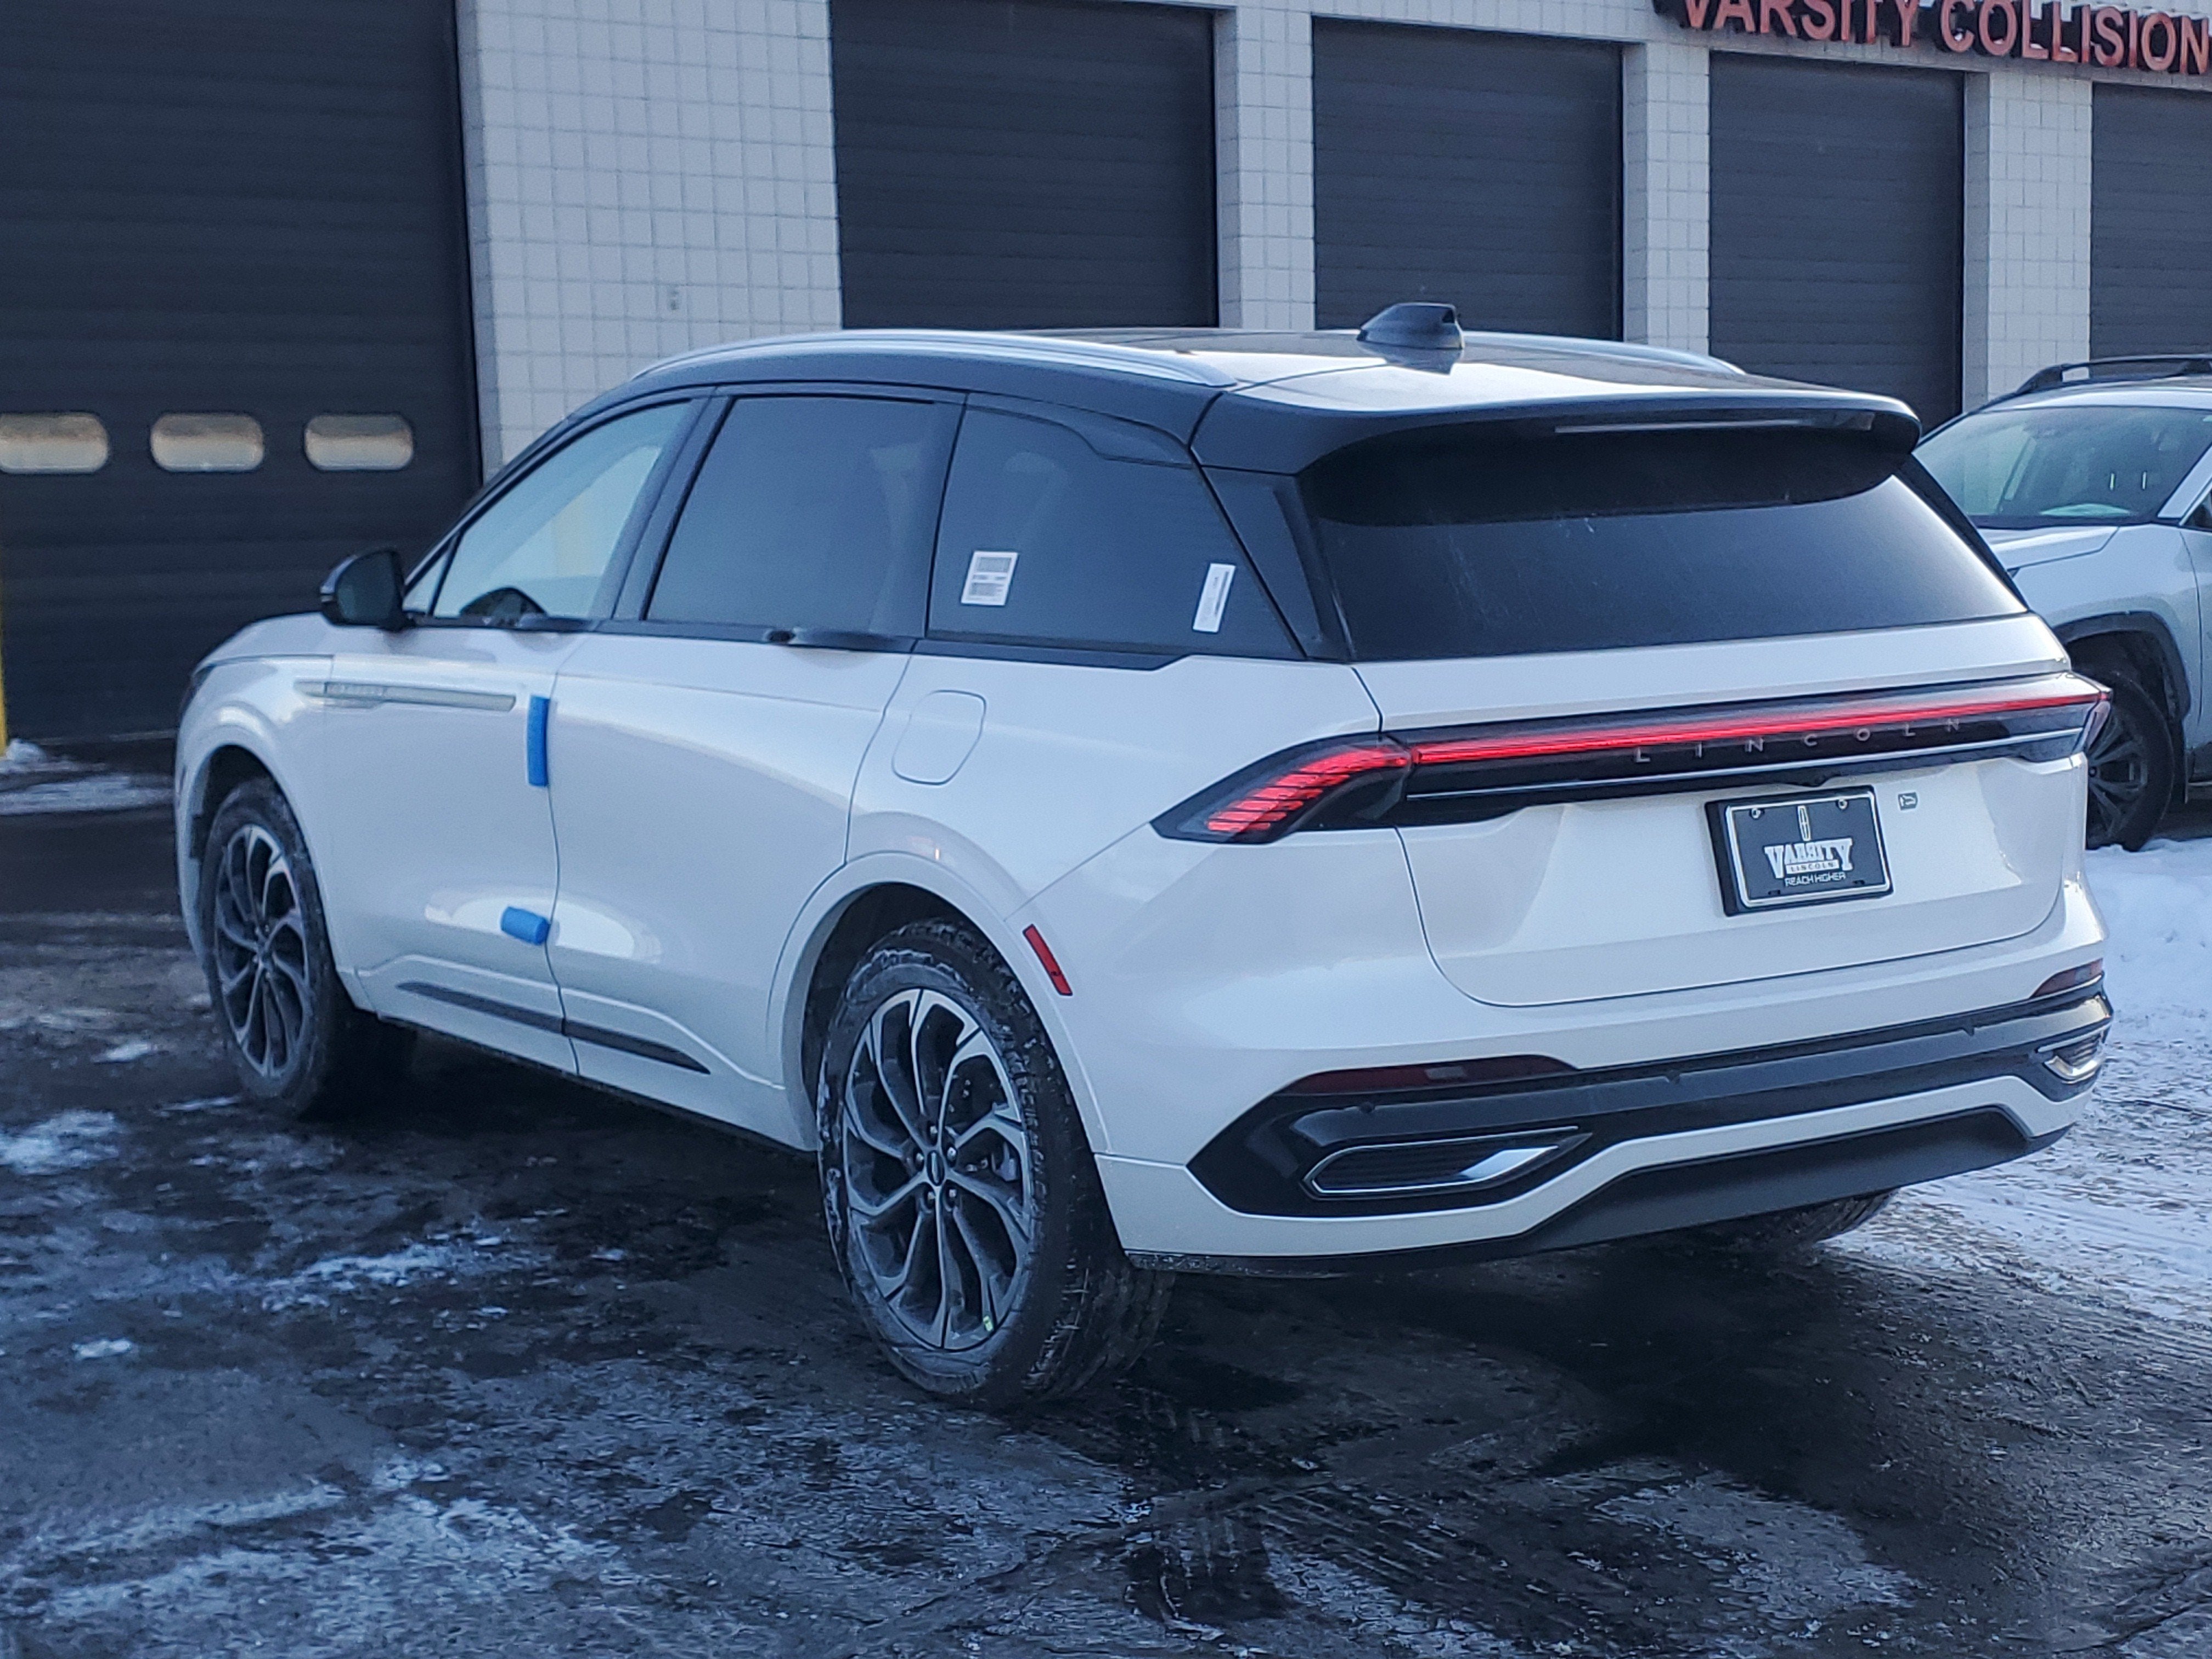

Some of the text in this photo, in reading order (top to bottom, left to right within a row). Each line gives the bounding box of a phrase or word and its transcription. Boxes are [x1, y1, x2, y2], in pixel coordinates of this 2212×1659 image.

[1940, 0, 2209, 75] COLLISION
[1635, 718, 1960, 763] LINCOLN
[1764, 837, 1853, 879] VARSITY
[1790, 861, 1835, 872] LINCOLN
[1784, 875, 1814, 887] REACH
